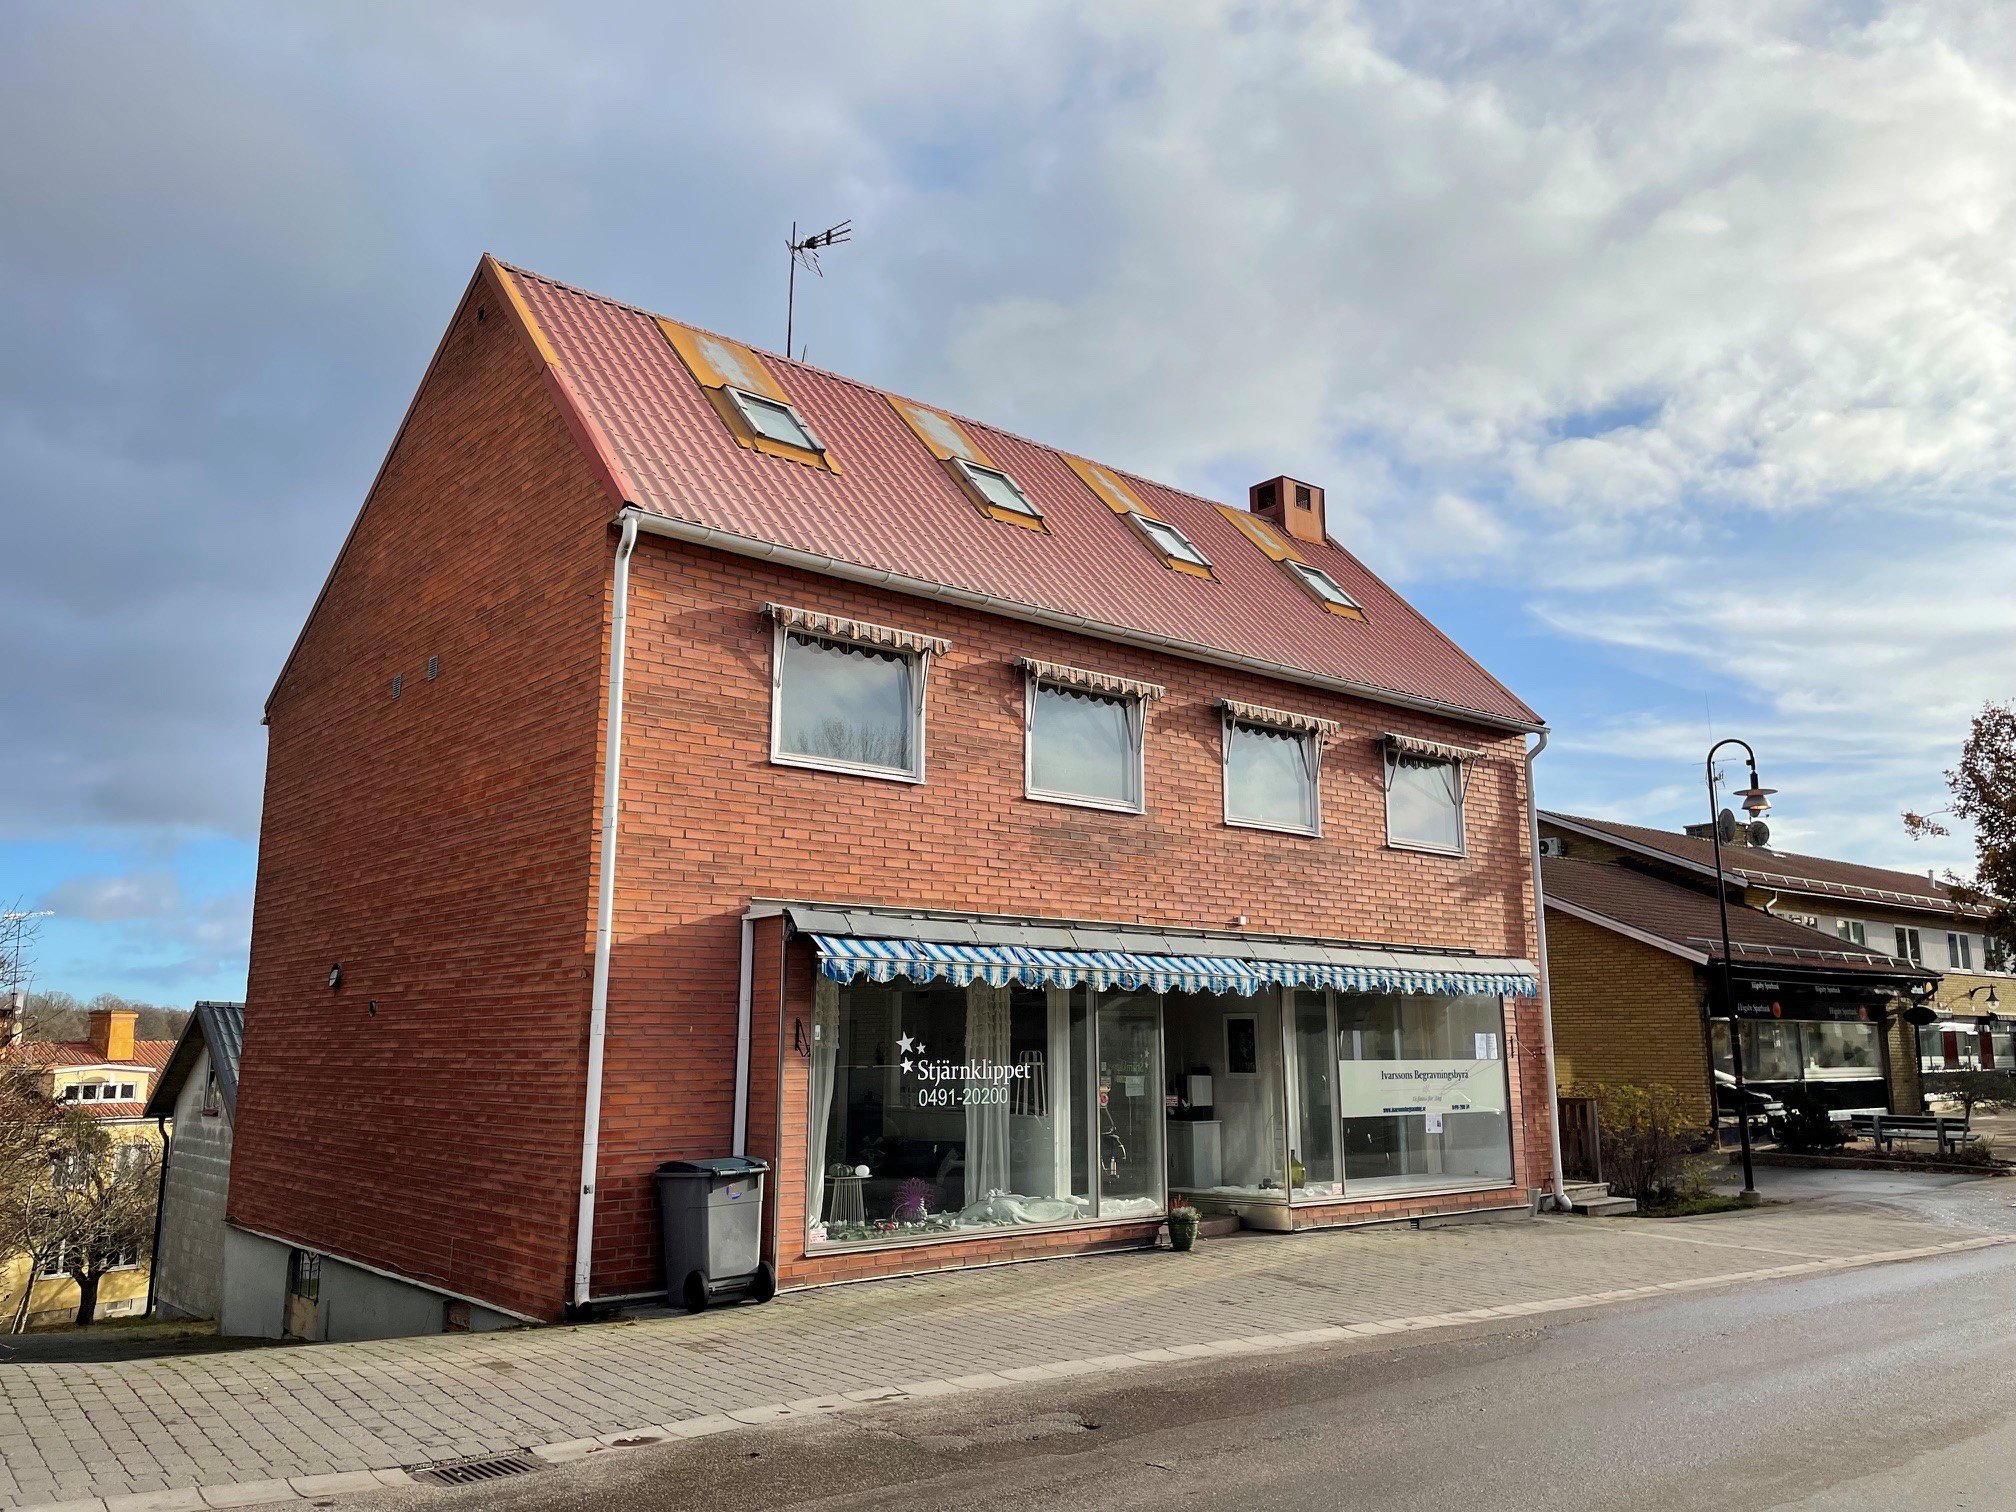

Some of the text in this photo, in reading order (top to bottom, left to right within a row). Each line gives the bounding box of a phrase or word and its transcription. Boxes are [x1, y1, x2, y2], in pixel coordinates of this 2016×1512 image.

[917, 1058, 1031, 1086] Stjärnklippet
[1381, 1069, 1469, 1082] Ivarssons Begravningsbyrå
[918, 1087, 1008, 1107] 0491-20200
